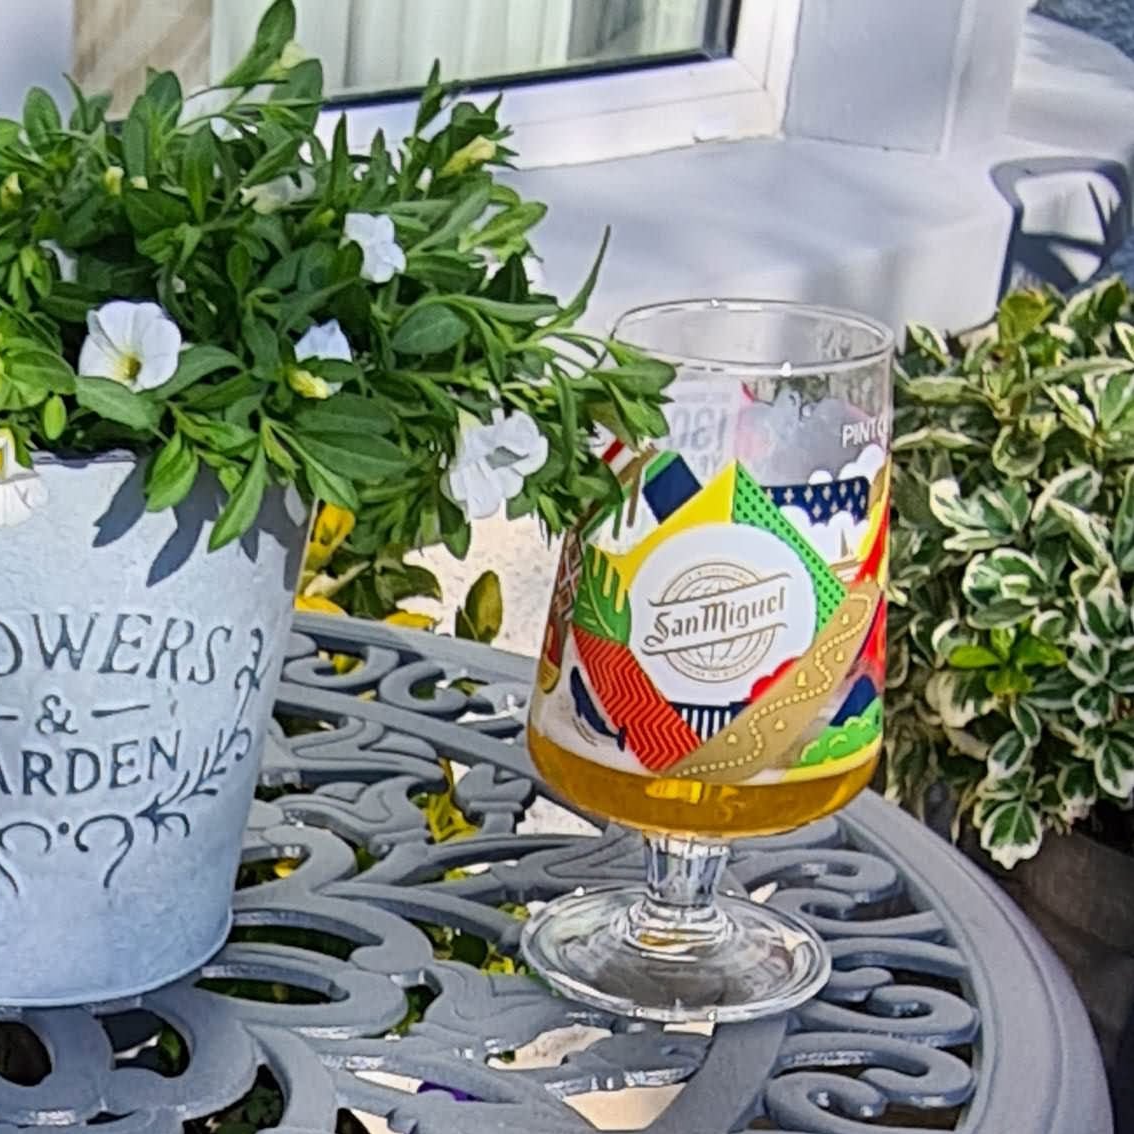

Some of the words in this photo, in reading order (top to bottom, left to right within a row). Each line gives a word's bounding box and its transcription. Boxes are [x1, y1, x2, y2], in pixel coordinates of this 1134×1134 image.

[643, 611, 699, 648] San
[699, 586, 786, 633] Miguel
[34, 693, 79, 735] &
